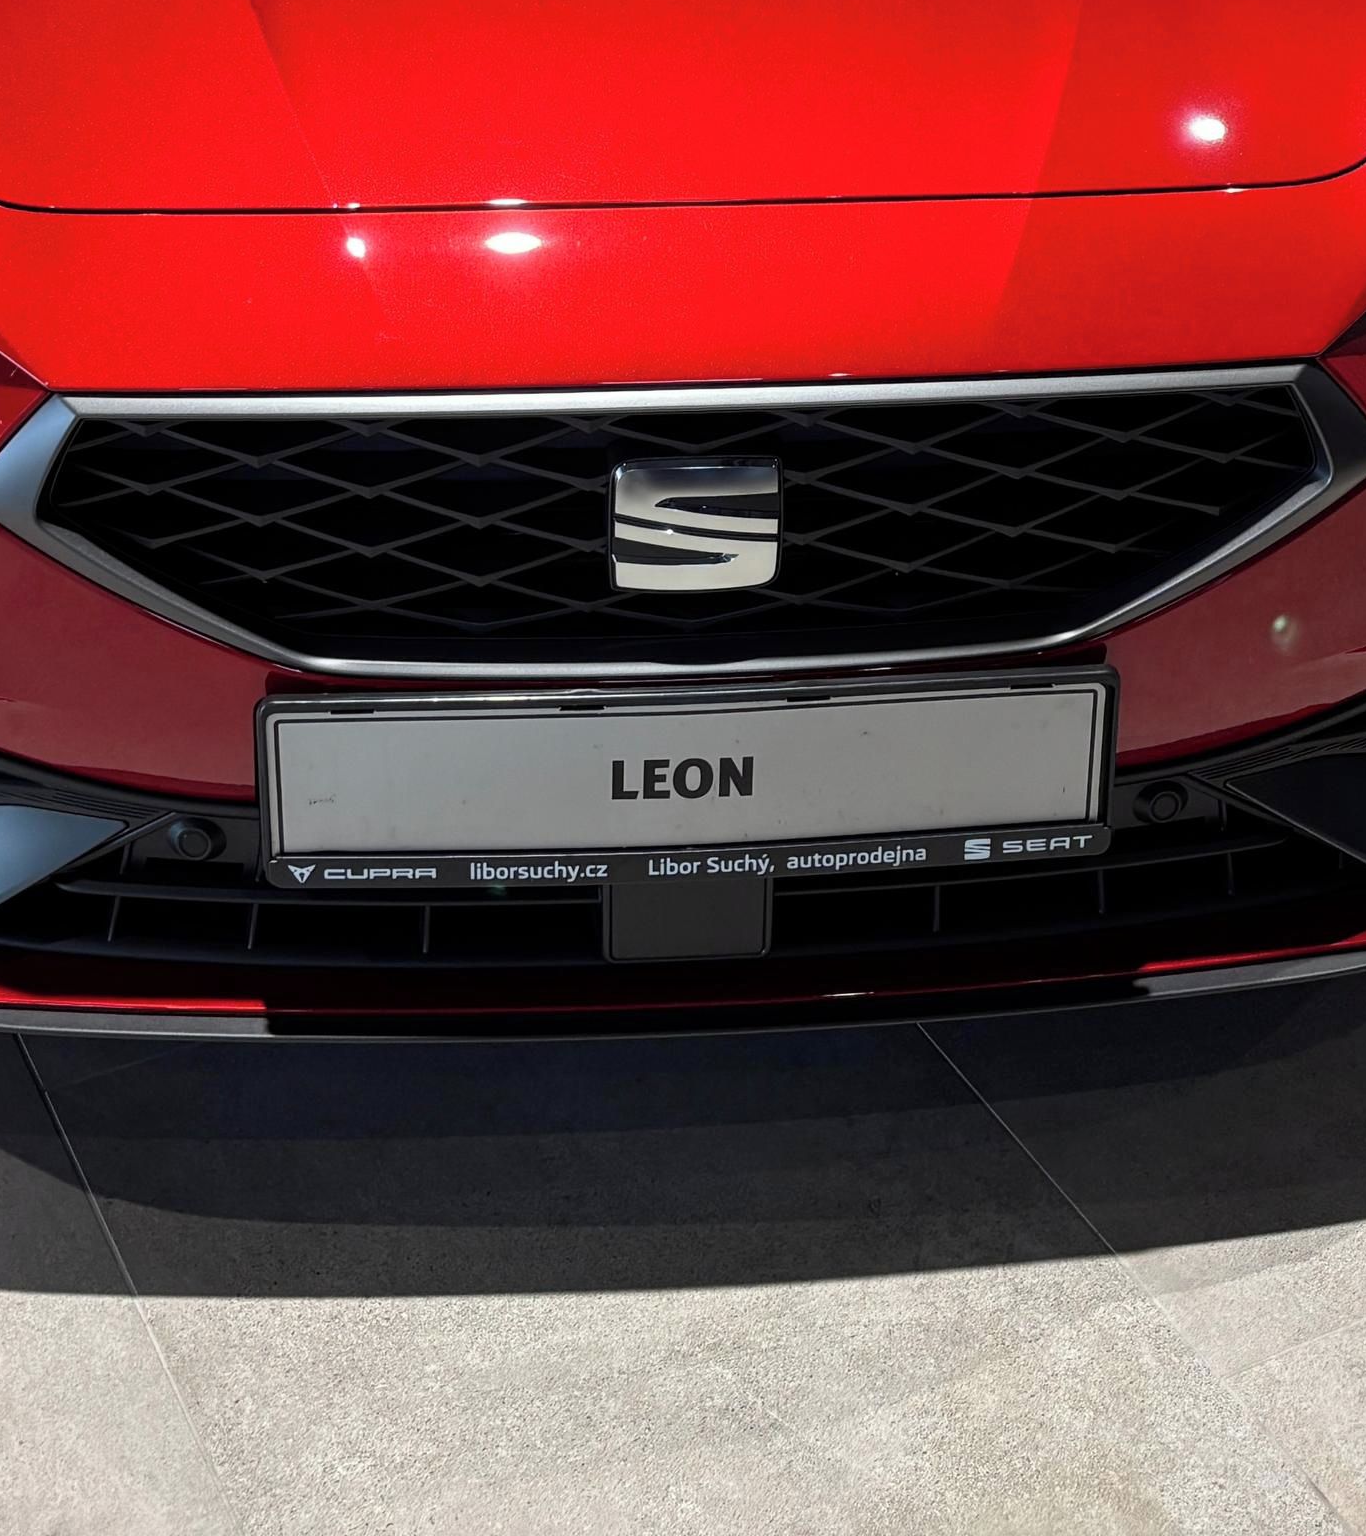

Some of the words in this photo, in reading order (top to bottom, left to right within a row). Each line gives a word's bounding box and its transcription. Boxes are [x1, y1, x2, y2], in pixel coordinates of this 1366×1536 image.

[611, 756, 755, 801] LEON
[323, 867, 437, 881] CUPRA
[469, 861, 608, 883] liborsuchy.cz
[648, 856, 701, 876] Libor
[706, 854, 775, 876] Suchý,
[786, 845, 927, 871] autoprodejna
[1002, 834, 1093, 855] SEAT
